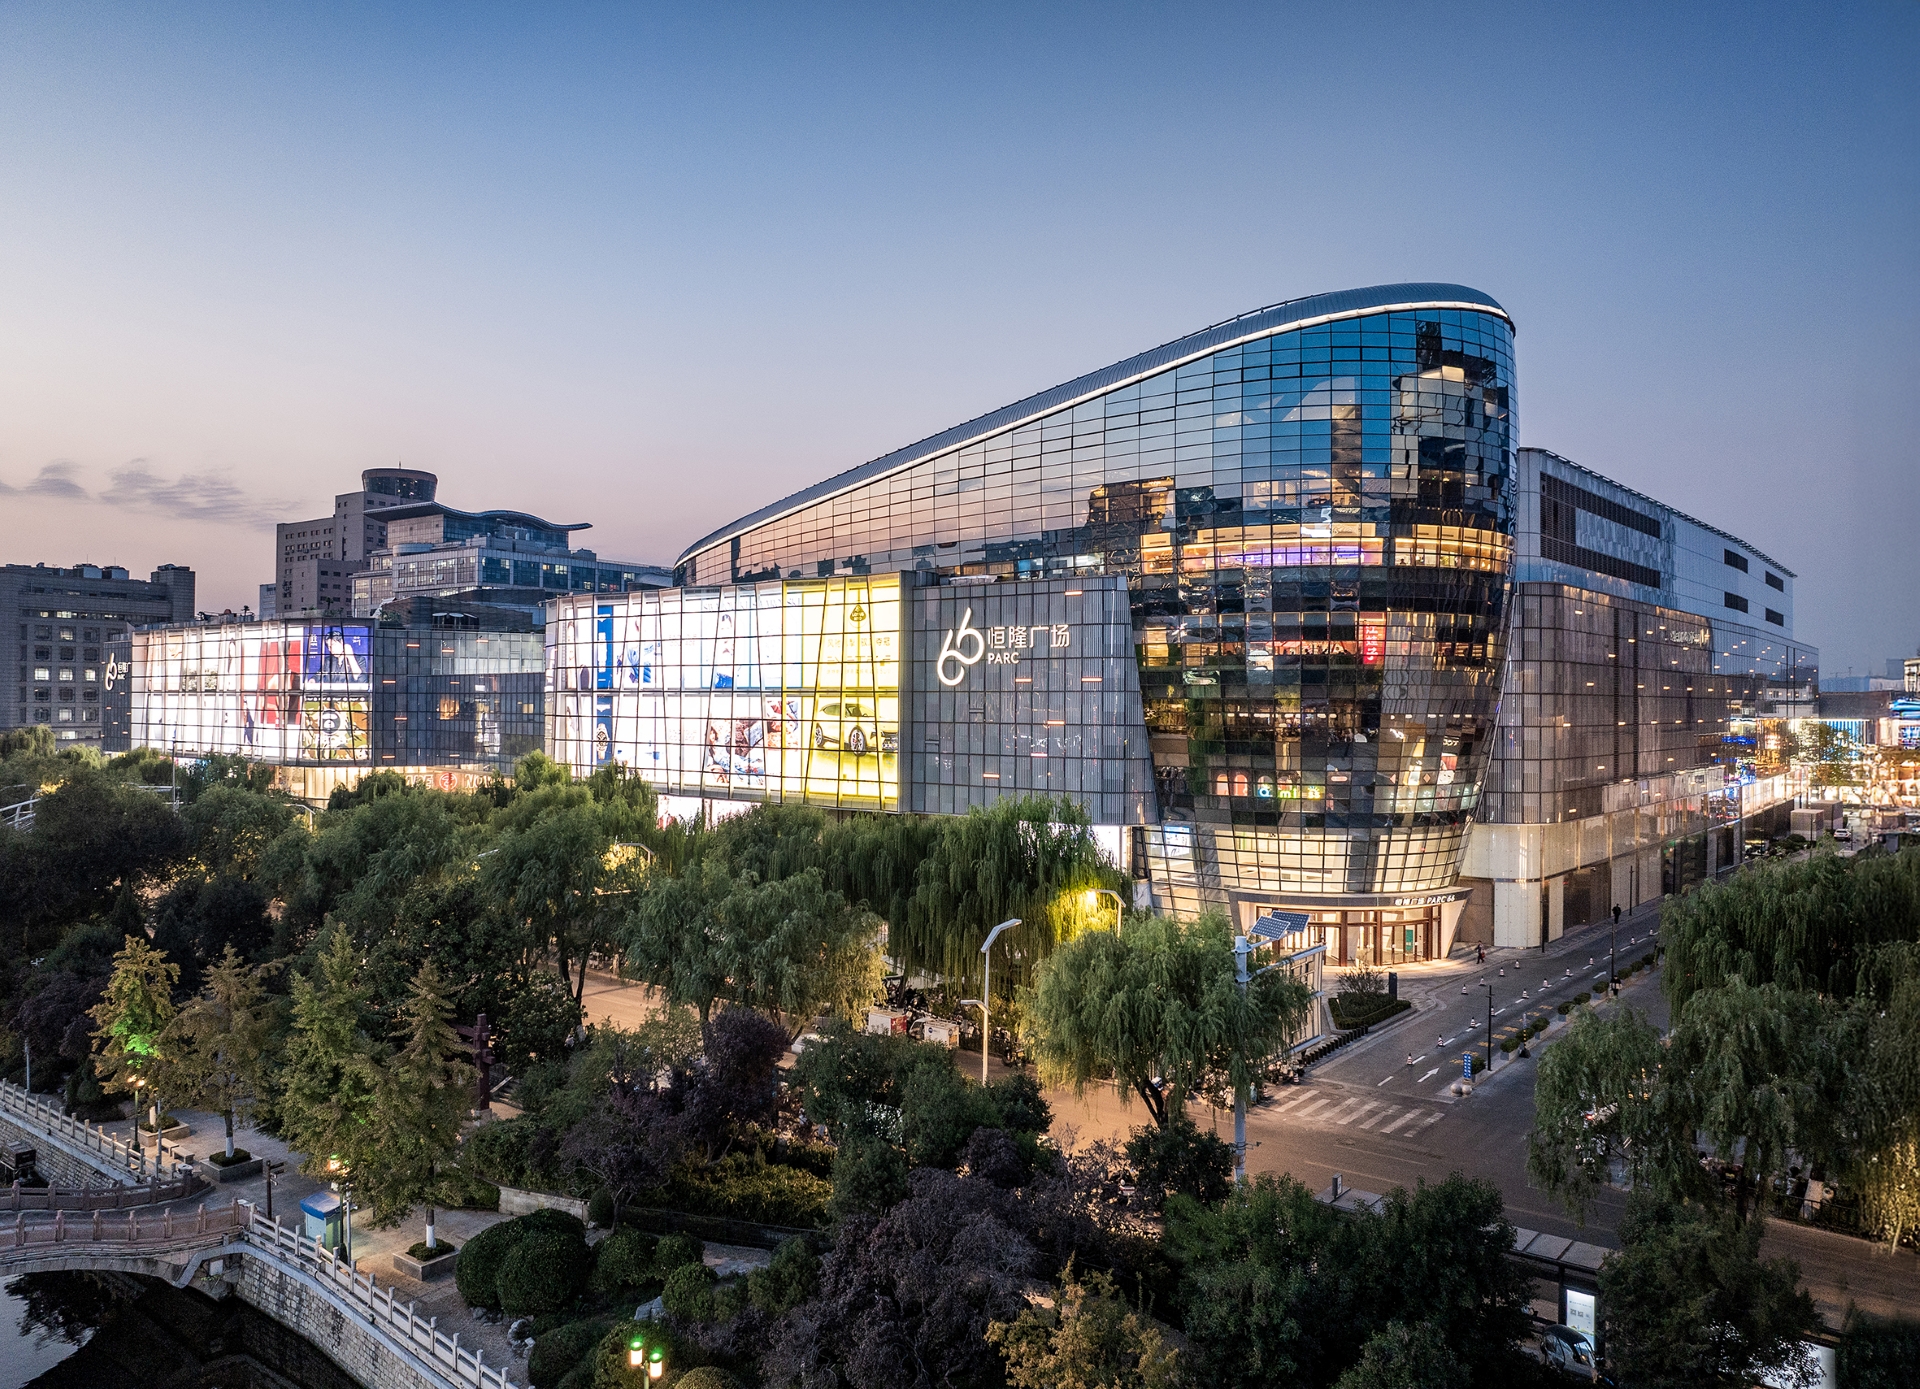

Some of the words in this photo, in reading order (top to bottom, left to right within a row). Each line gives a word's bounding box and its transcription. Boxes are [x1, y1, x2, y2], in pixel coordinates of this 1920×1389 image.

[987, 624, 1071, 649] 恒隆广场
[987, 652, 1020, 665] PARC
[1427, 896, 1445, 904] PARC
